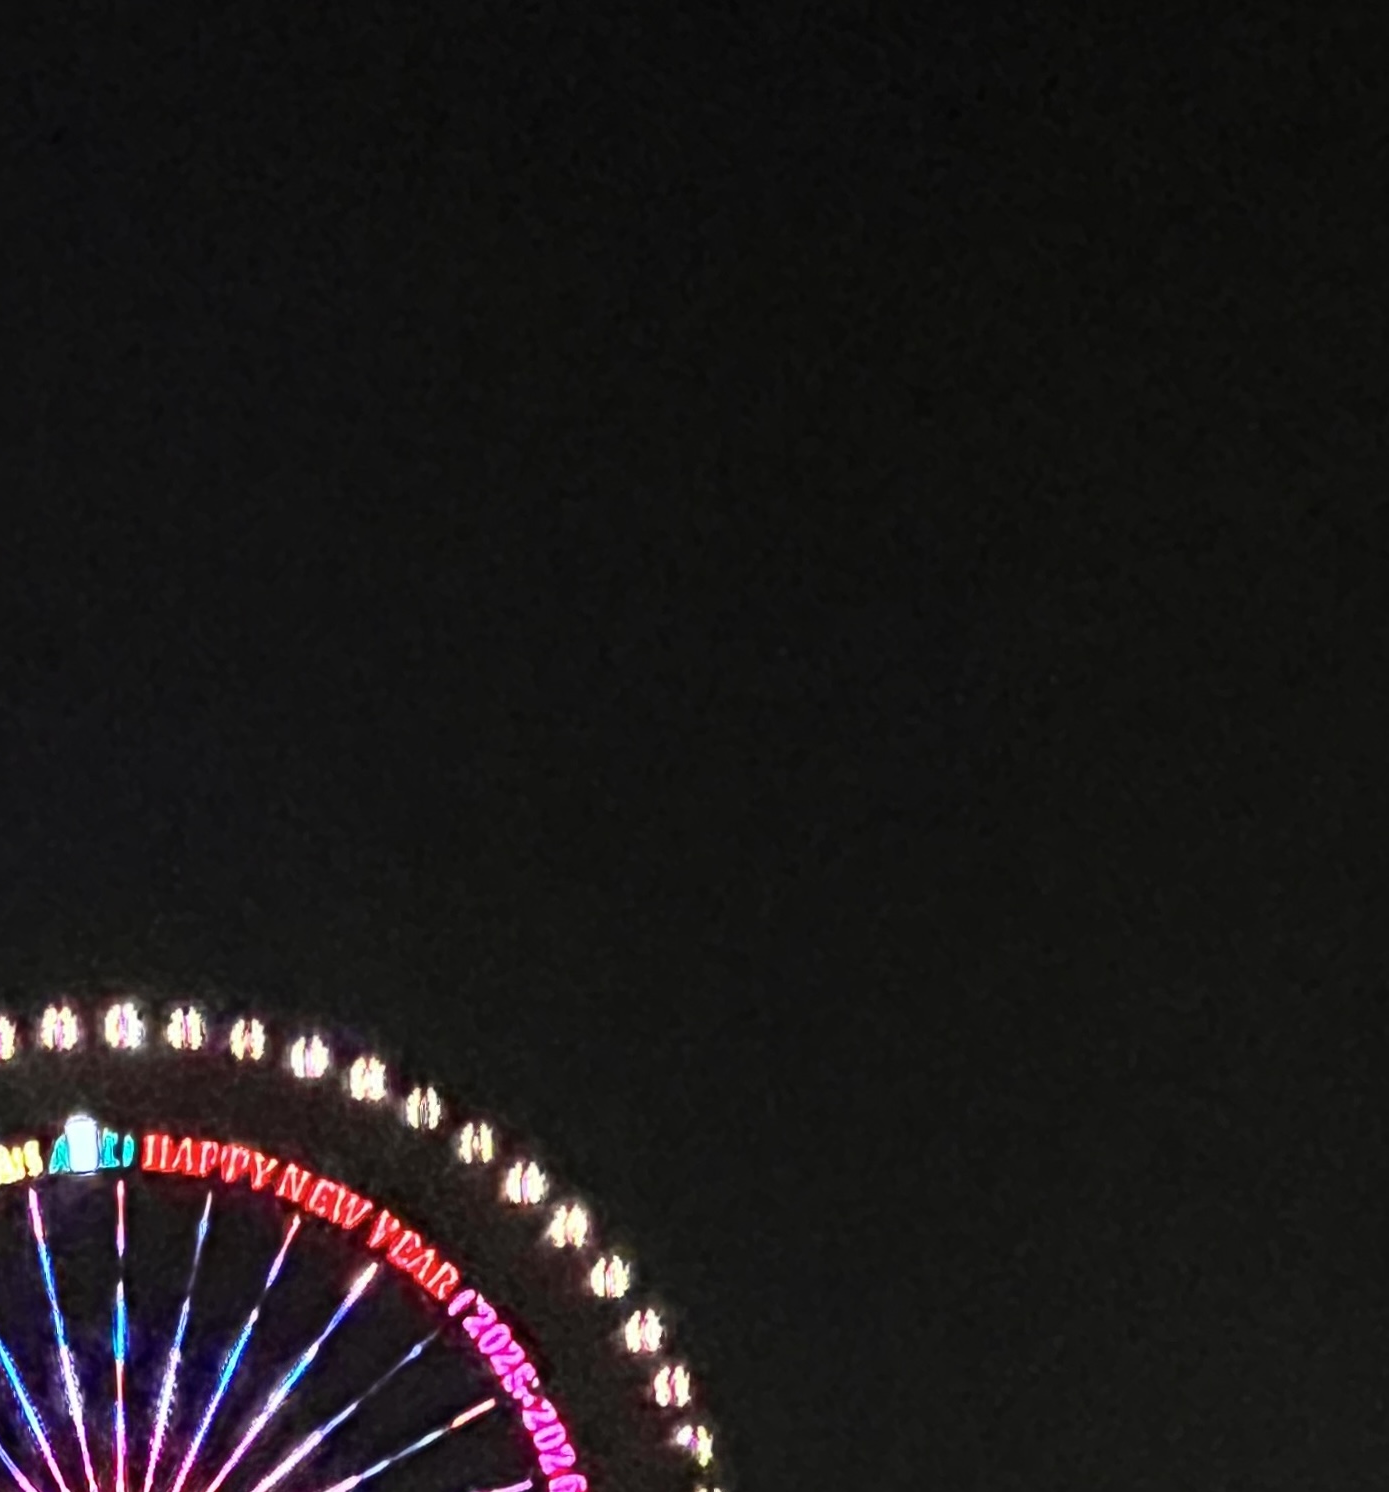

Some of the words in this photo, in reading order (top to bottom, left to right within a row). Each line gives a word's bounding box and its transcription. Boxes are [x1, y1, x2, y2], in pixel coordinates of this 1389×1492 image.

[140, 1132, 279, 1191] HAPPY
[275, 1162, 373, 1230] NEW
[364, 1208, 461, 1301] YEAR
